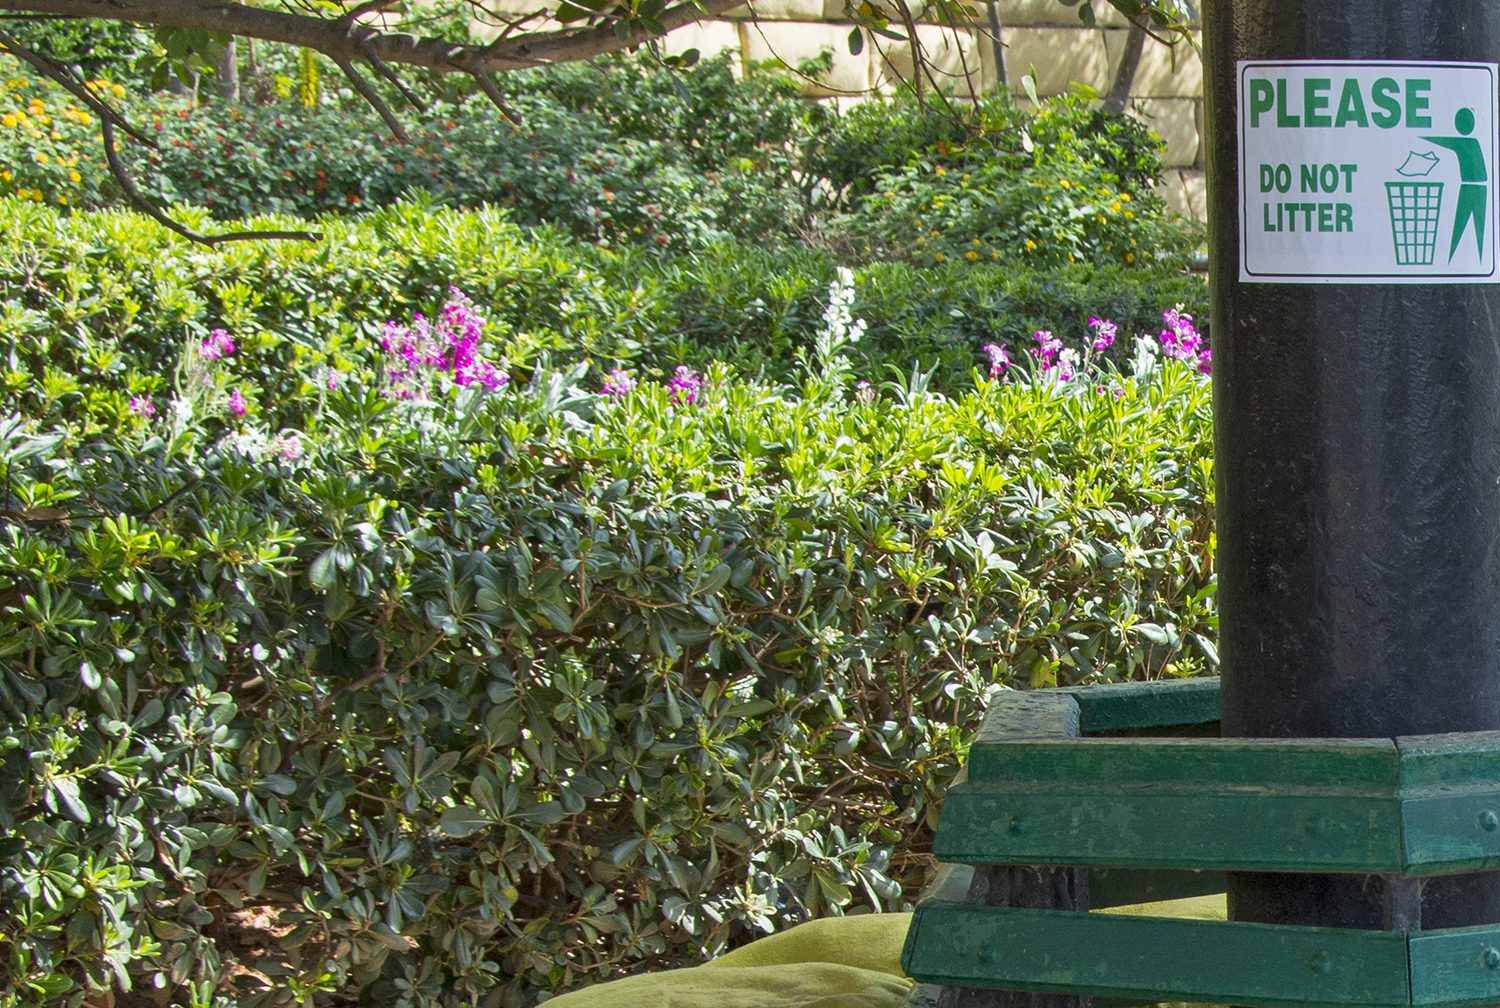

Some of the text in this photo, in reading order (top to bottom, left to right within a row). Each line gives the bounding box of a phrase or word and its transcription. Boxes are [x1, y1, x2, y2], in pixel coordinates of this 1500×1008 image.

[1250, 77, 1433, 129] PLEASE
[1260, 163, 1357, 194] DO NOT
[1263, 203, 1354, 232] LITTER
